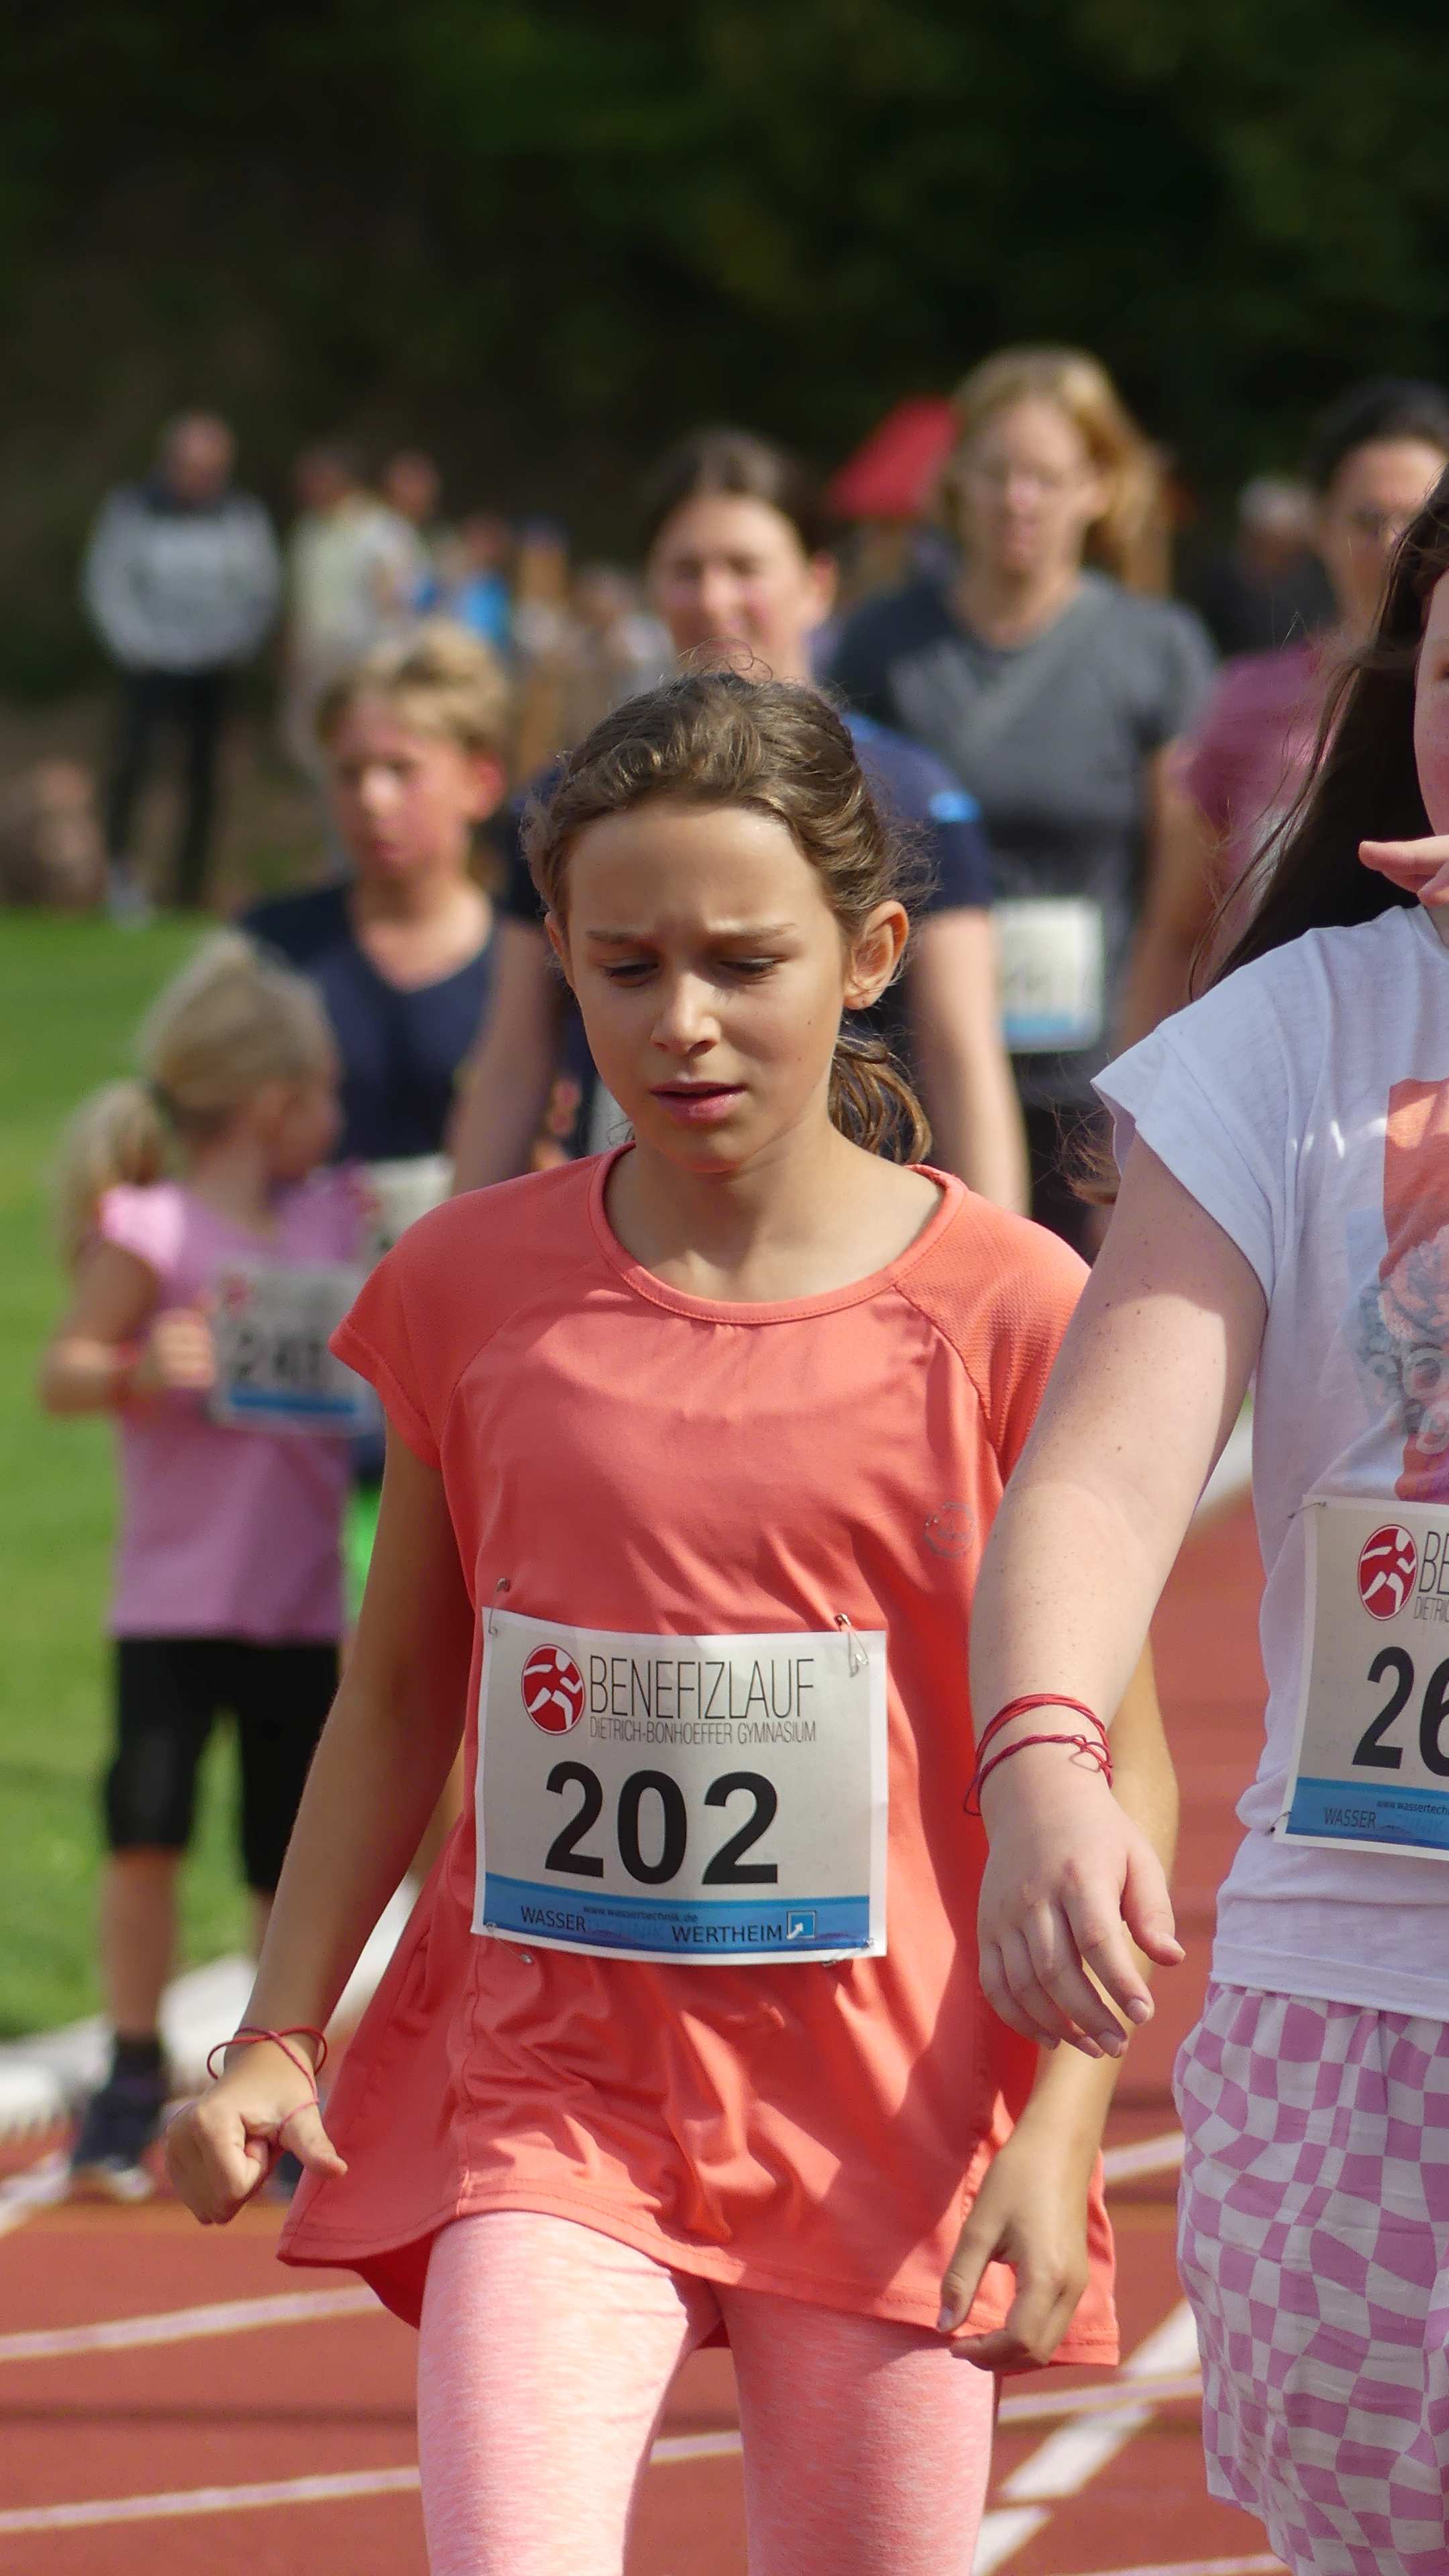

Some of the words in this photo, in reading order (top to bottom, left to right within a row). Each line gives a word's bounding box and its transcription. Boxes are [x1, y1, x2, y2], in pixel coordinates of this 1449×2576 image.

[590, 1655, 814, 1719] BENEFIZLAUF
[590, 1717, 733, 1744] DIETRICH-BONHOEFFER
[738, 1721, 816, 1744] GYMNASIUM
[545, 1761, 778, 1884] 202
[1324, 1808, 1376, 1829] WASSER
[521, 1905, 586, 1933] WASSER
[672, 1923, 782, 1943] WERTHEIM
